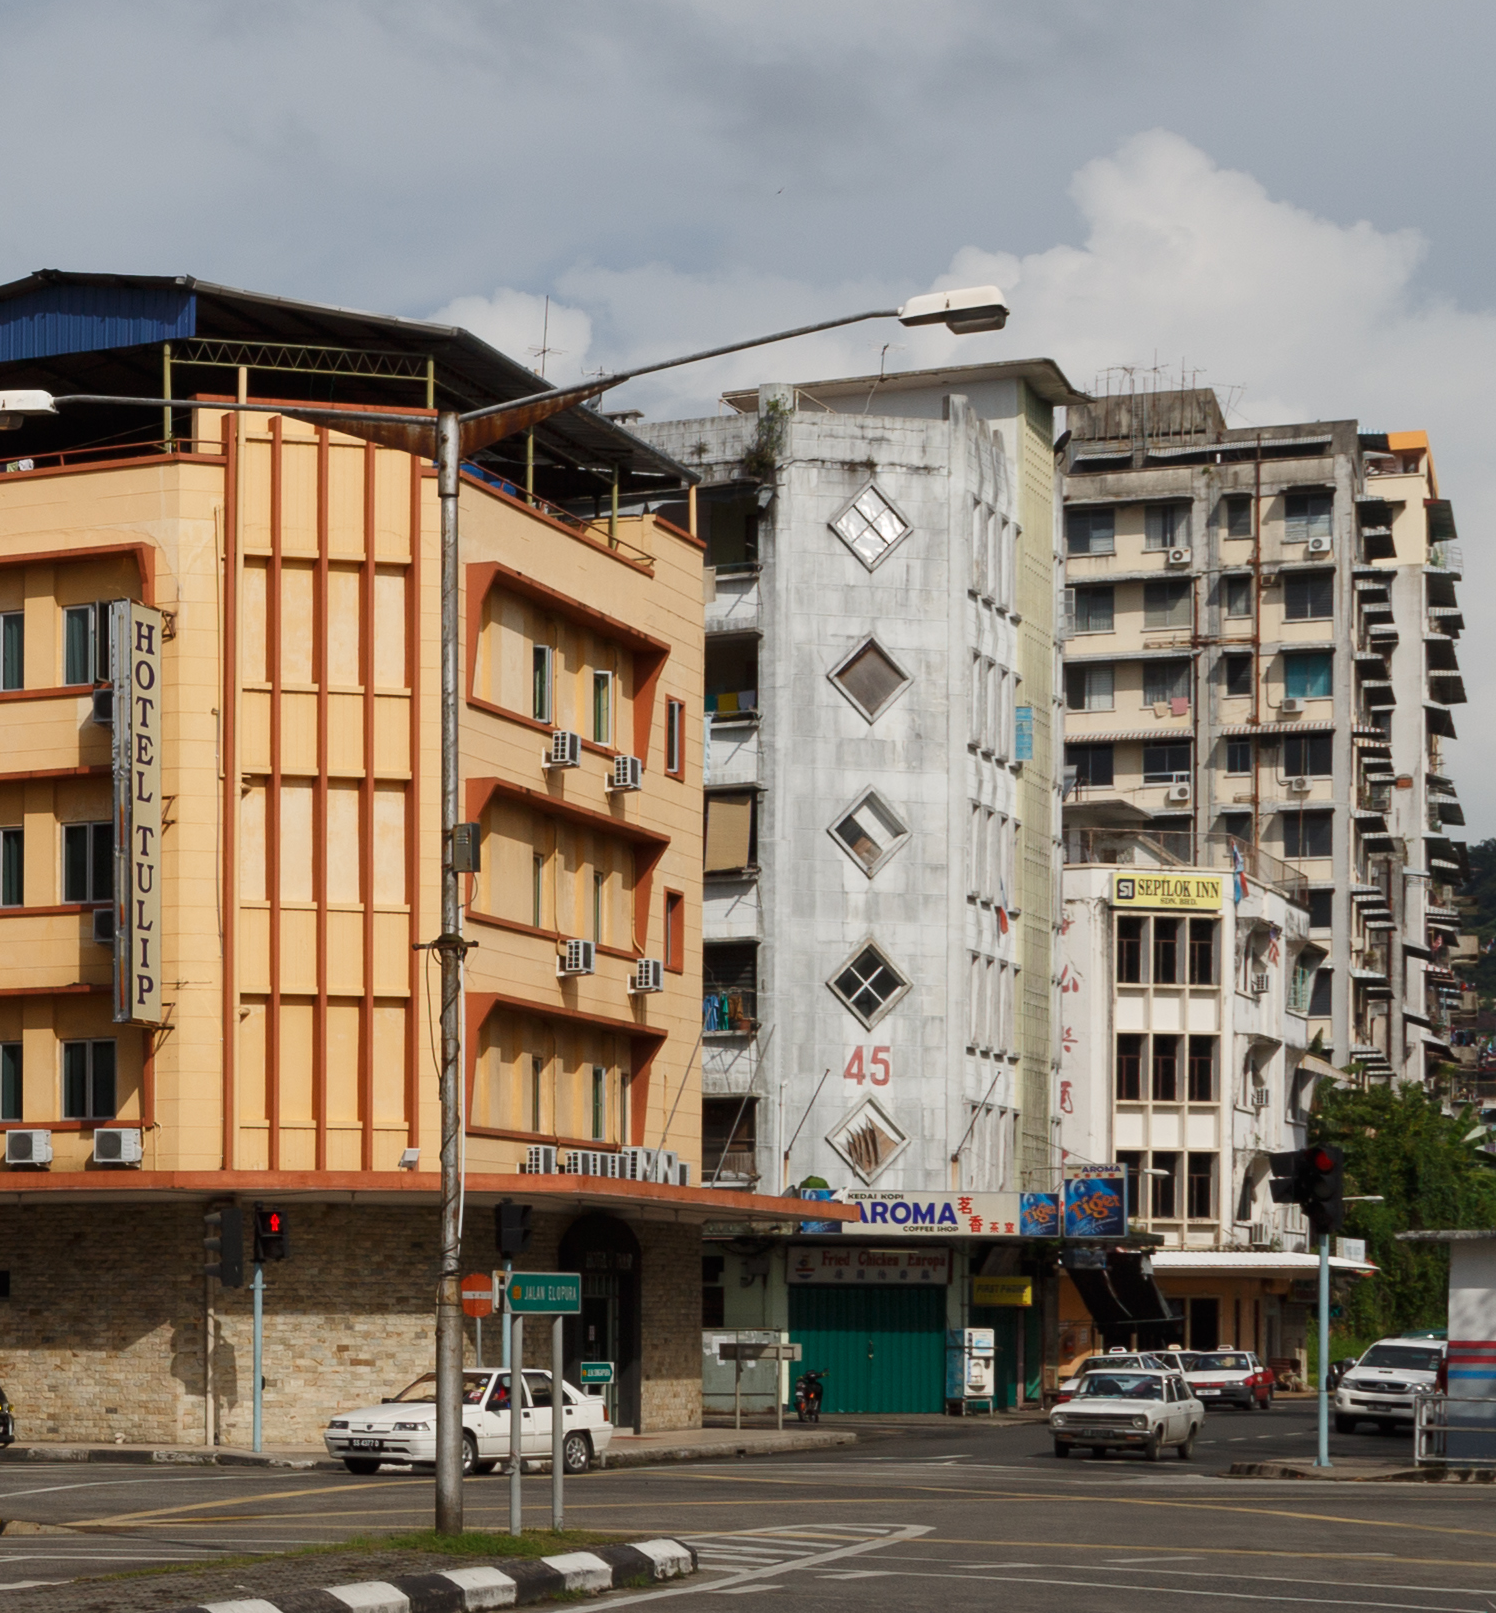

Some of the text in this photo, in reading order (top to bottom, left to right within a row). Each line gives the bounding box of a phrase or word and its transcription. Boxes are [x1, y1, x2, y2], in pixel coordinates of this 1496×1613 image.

[135, 621, 155, 1006] HOTEL TULIP
[1138, 878, 1191, 897] SEPILOK
[1196, 881, 1219, 898] INN
[843, 1045, 890, 1086] 45
[1022, 1202, 1057, 1224] Tiger
[1068, 1191, 1121, 1220] Tiger
[902, 1225, 959, 1233] COFFEE SHOP
[821, 1250, 851, 1267] Fried
[858, 1251, 900, 1267] Chicken
[524, 1286, 546, 1301] JALAN
